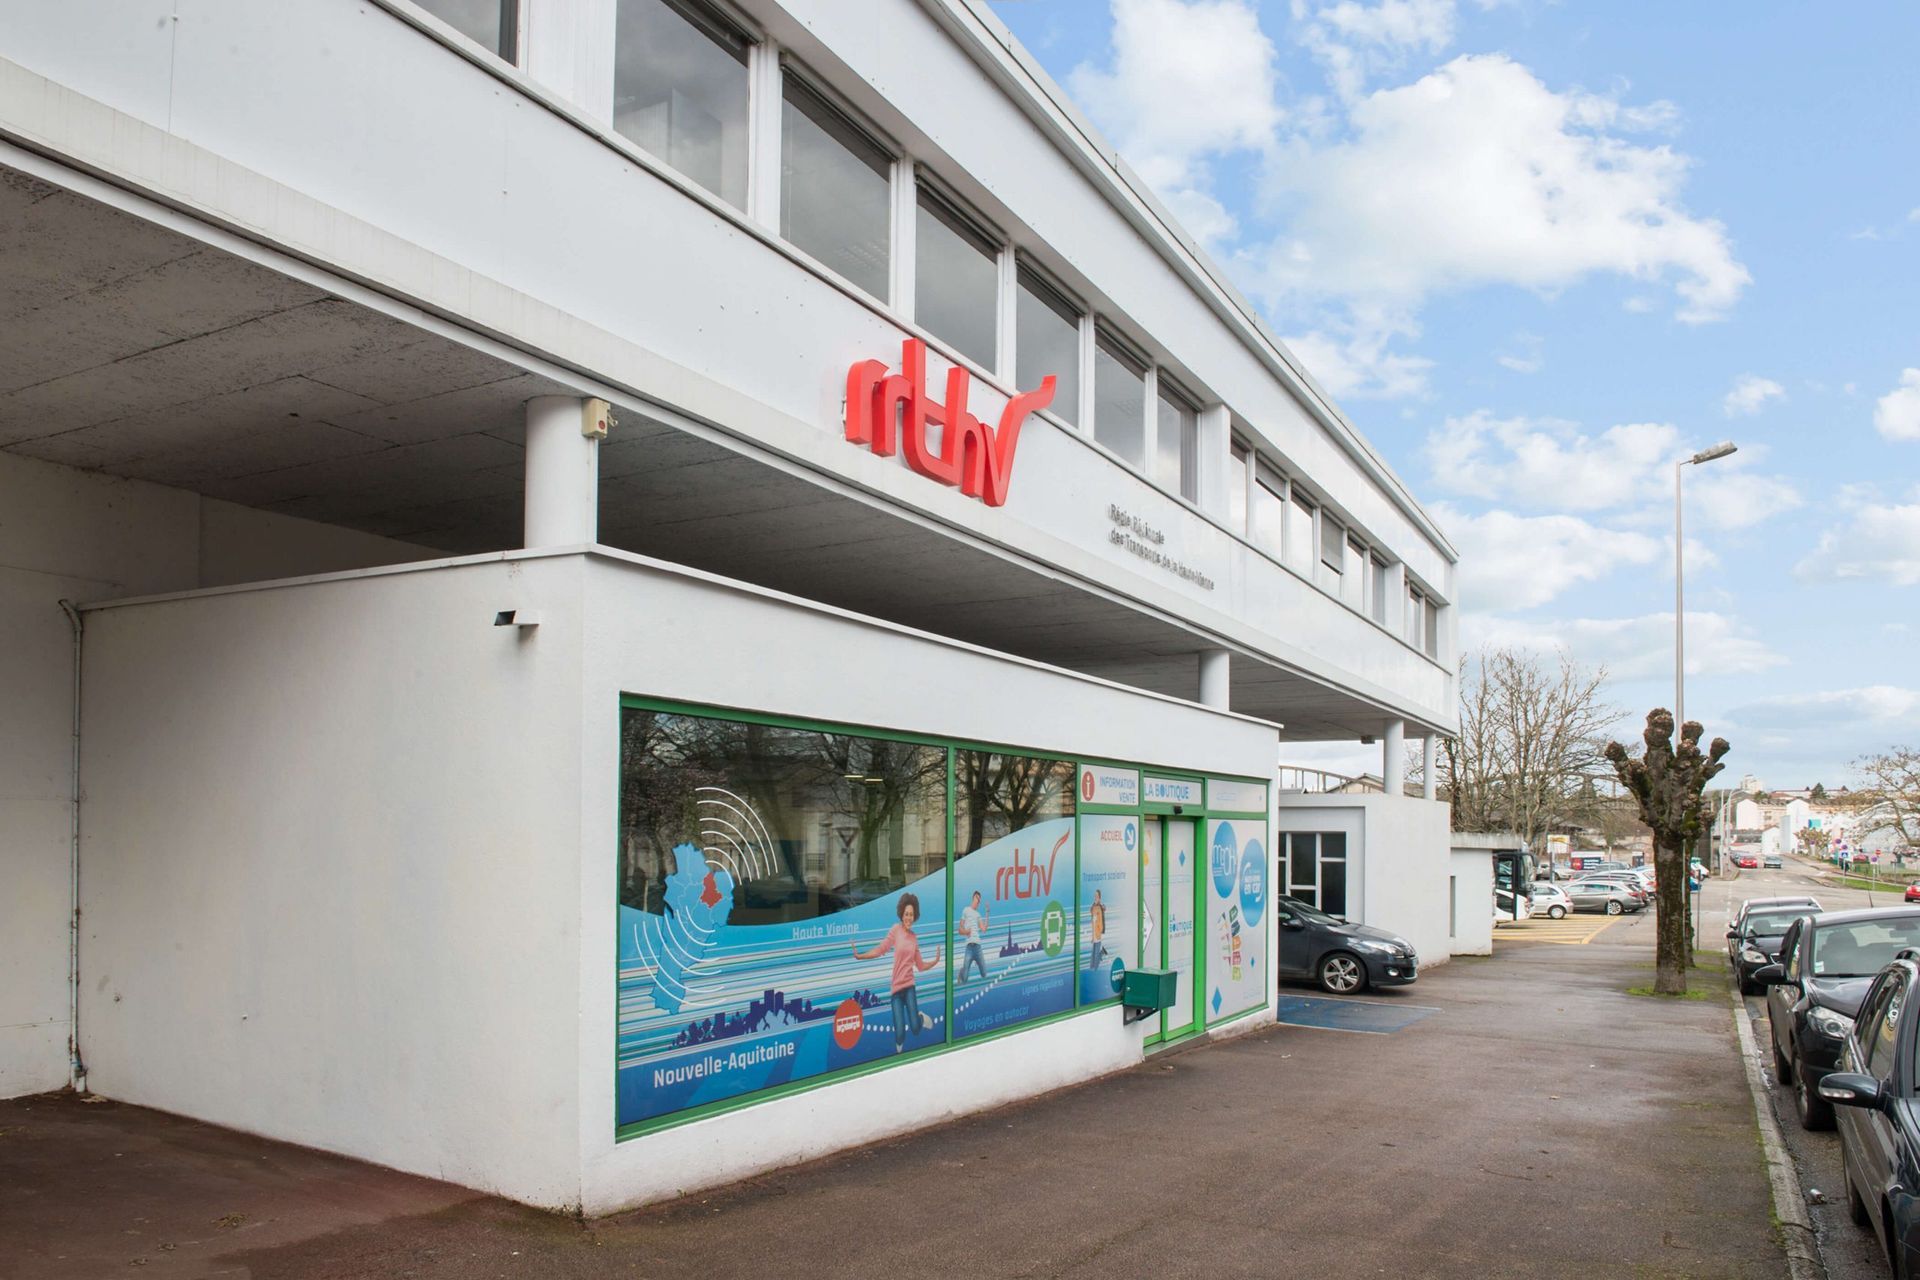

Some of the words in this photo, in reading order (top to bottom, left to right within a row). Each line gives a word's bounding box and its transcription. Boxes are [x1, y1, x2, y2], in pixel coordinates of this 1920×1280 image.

[1100, 776, 1136, 790] INFORMATION
[1145, 783, 1154, 797] LA
[1155, 784, 1190, 800] BOUTIQUE
[1119, 792, 1136, 804] VENTE
[1100, 830, 1123, 841] ACCUEIL
[792, 924, 823, 940] Haute
[826, 922, 860, 935] Vienne
[964, 1015, 994, 1032] Voyages
[995, 1012, 1003, 1022] en
[1004, 1006, 1029, 1020] autocar
[654, 1041, 795, 1088] Nouvelle-Aquitaine
